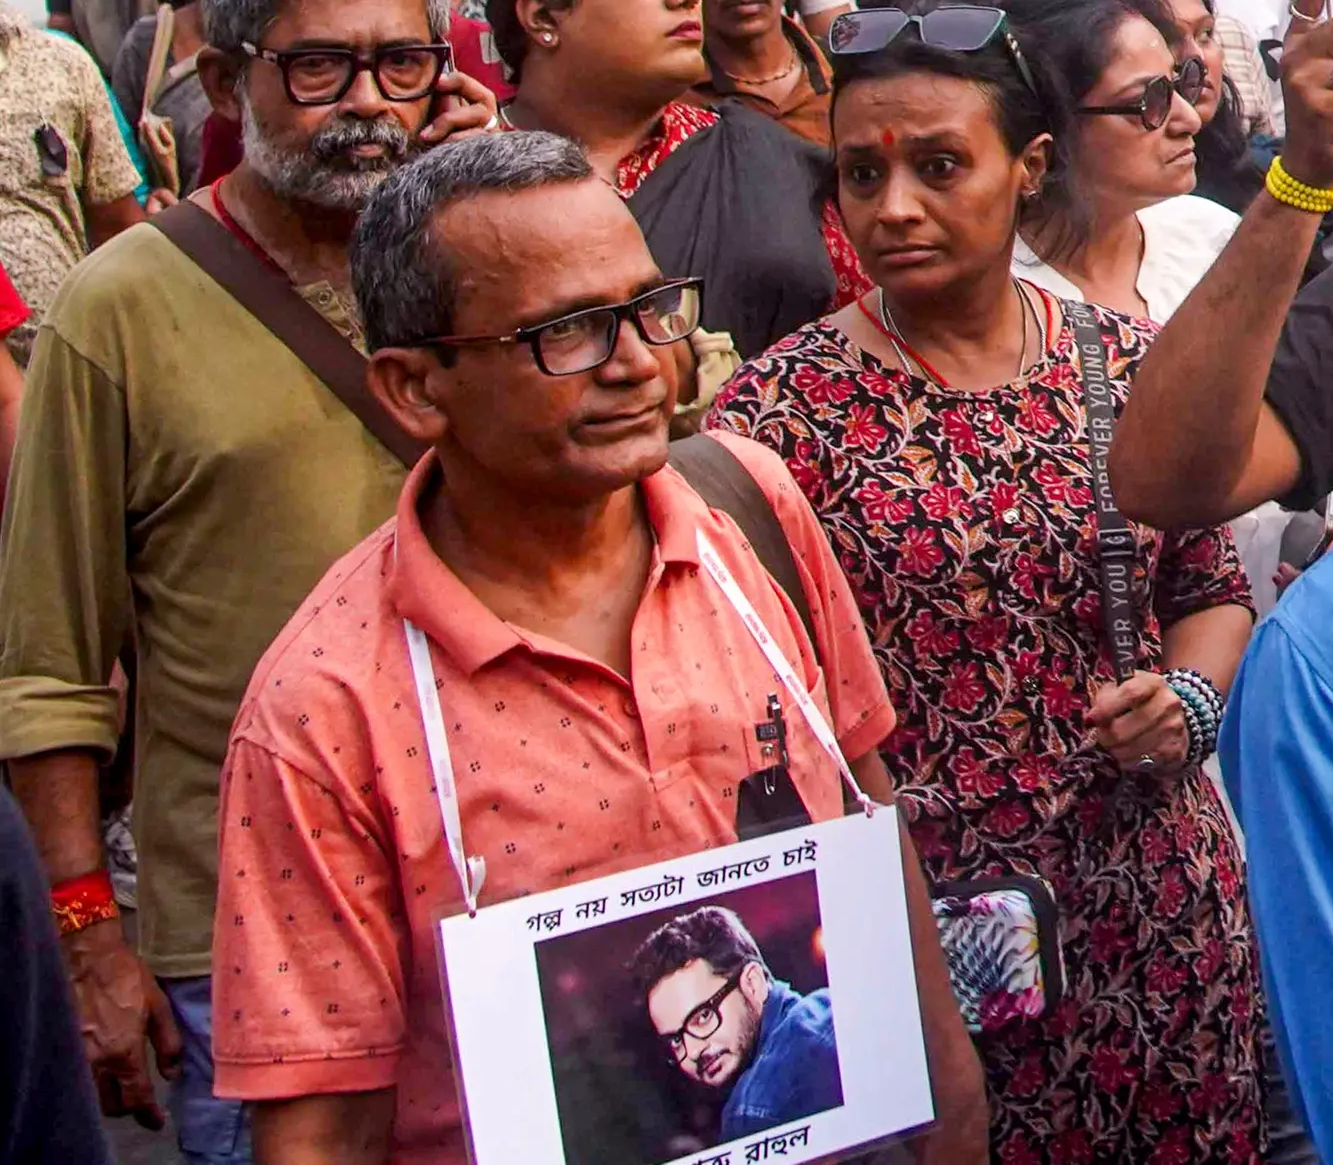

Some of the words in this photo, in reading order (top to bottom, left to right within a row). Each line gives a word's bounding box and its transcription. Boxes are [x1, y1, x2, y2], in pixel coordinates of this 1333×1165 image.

[1082, 343, 1109, 408] YOUNG
[1106, 564, 1129, 609] YOU
[526, 908, 563, 933] গল্প
[575, 895, 609, 920] নয়
[620, 873, 684, 909] সত্যটা
[697, 855, 772, 887] জানতে
[782, 839, 818, 867] চাই
[744, 1125, 812, 1165] রাহুল
